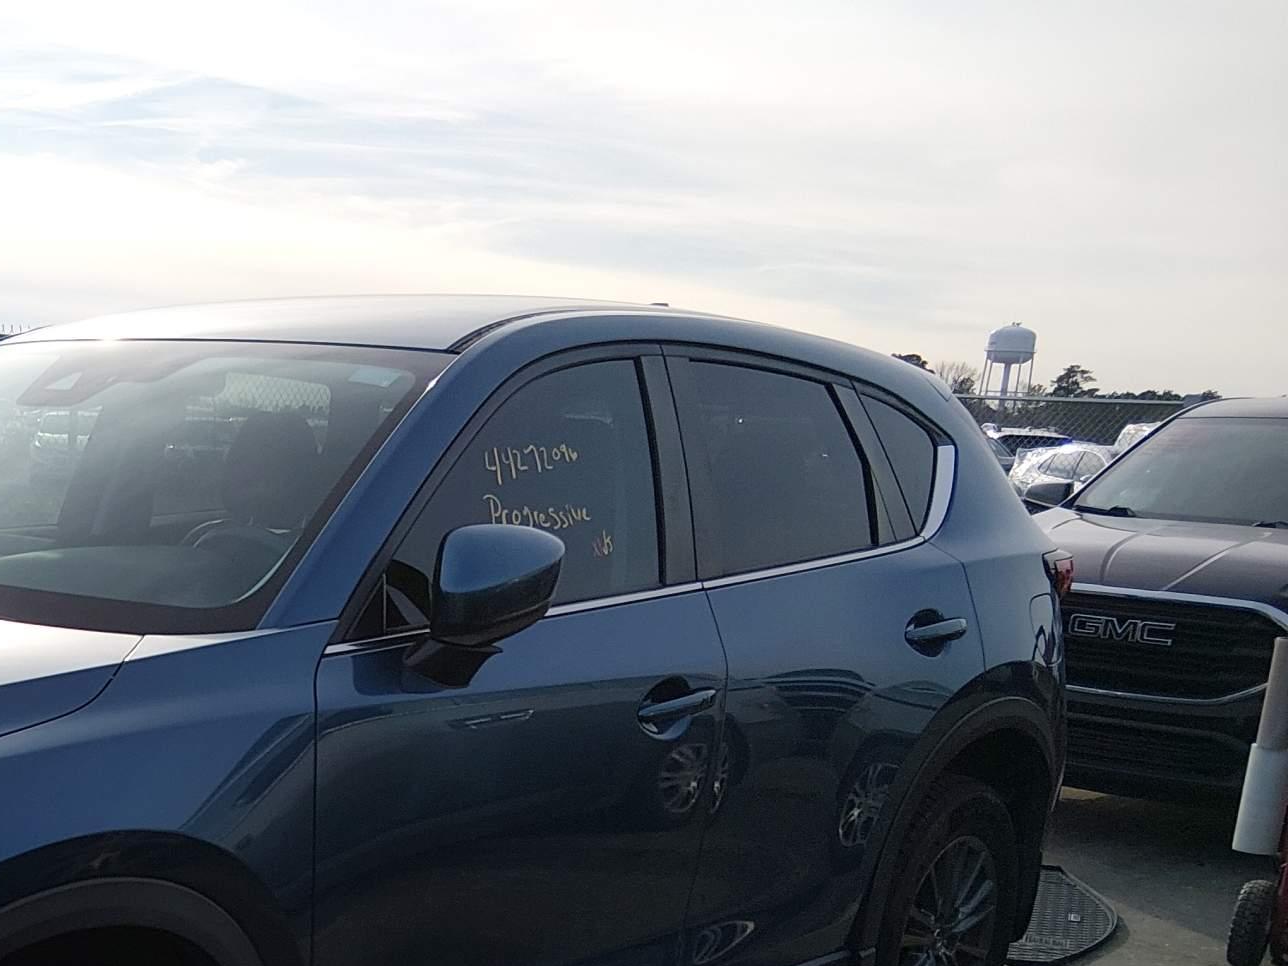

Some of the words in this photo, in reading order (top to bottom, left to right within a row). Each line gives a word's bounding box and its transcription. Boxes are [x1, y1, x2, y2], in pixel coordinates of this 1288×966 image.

[485, 444, 578, 486] 44272096
[482, 494, 592, 530] Progressive
[1068, 613, 1176, 646] GMC
